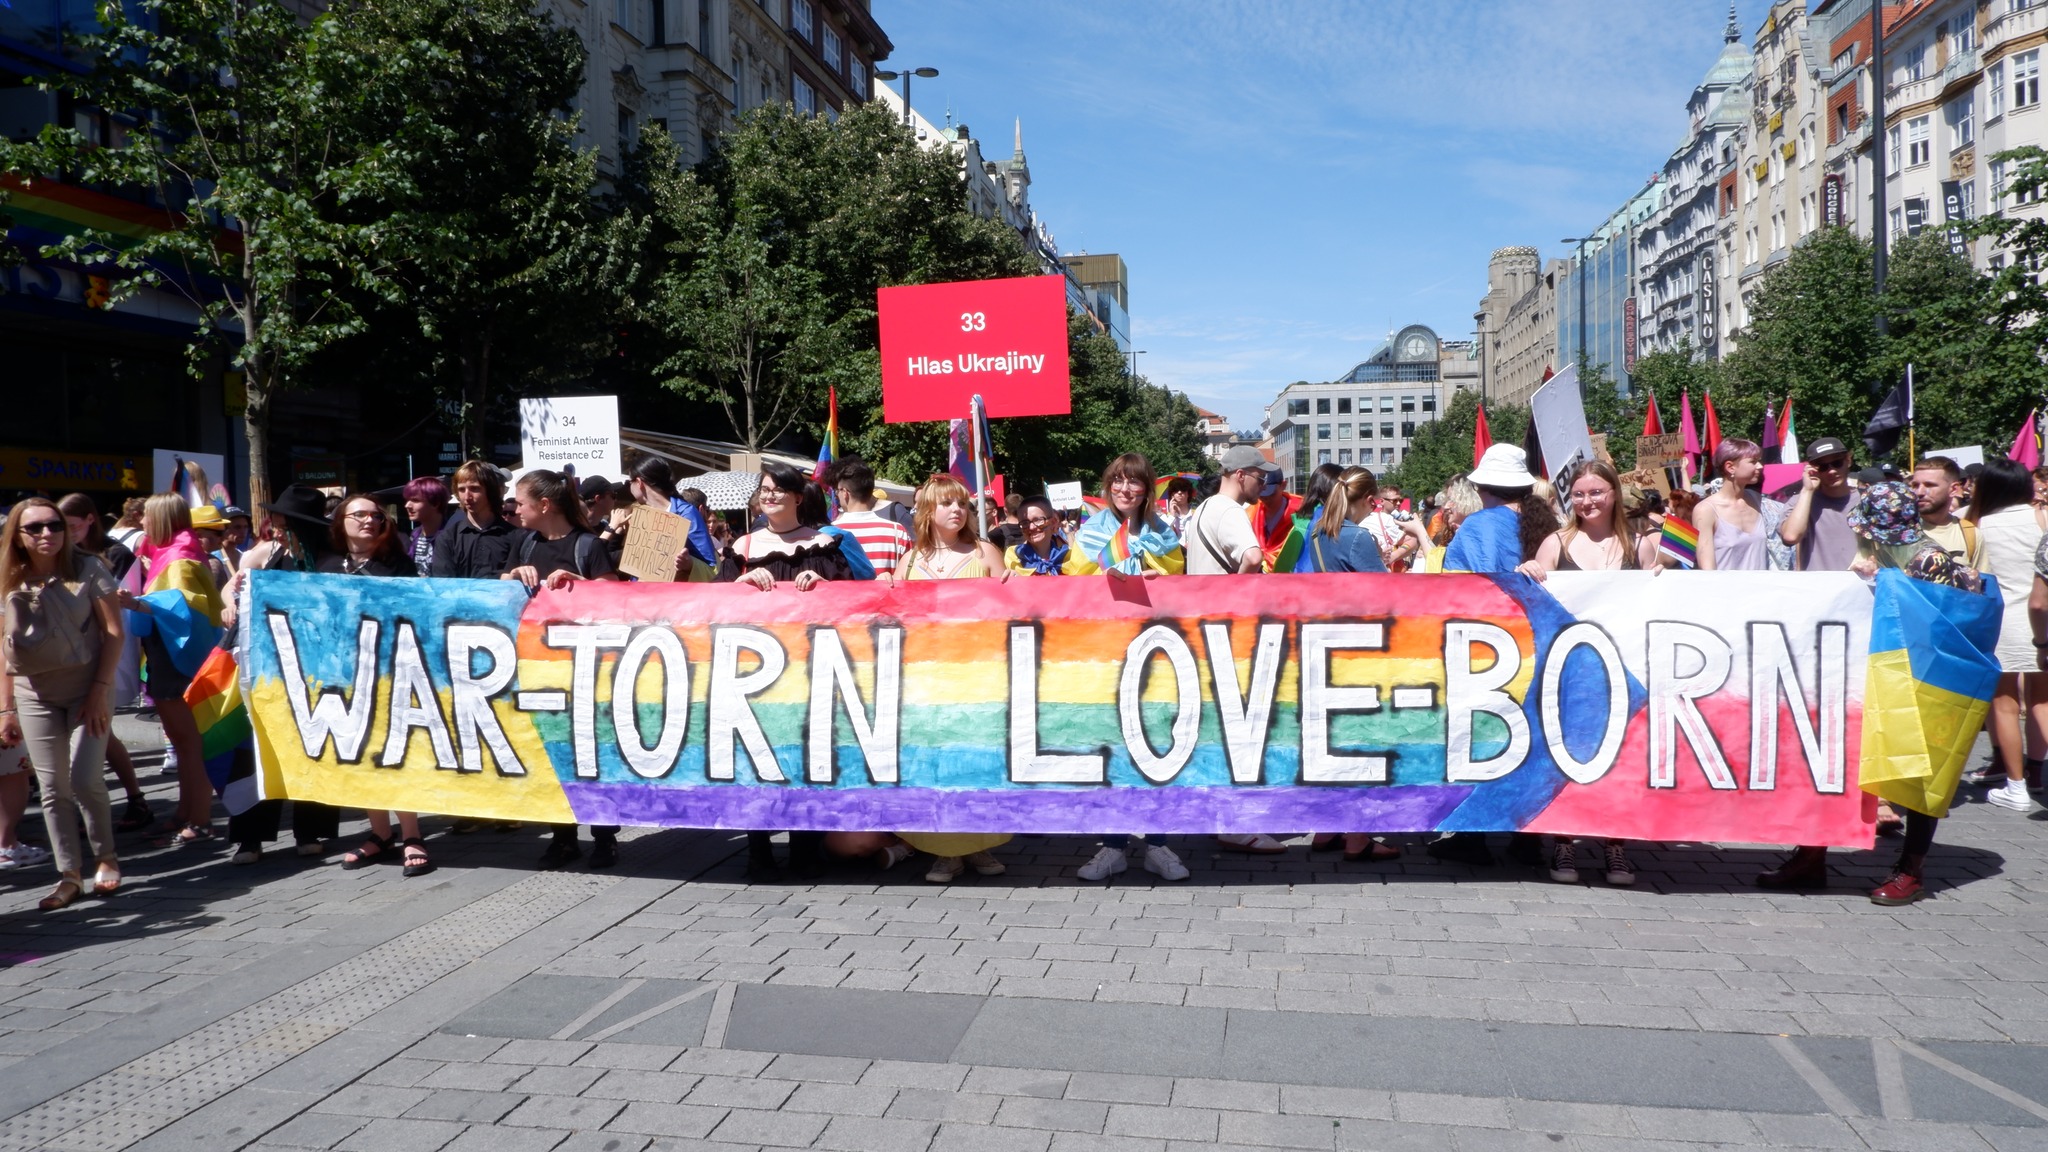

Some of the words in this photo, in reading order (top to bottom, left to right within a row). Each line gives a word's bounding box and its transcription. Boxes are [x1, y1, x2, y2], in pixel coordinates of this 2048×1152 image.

[1702, 256, 1713, 339] CASINO
[961, 312, 986, 332] 33
[908, 356, 954, 376] Hlas
[958, 351, 1045, 375] Ukrajiny
[562, 416, 576, 427] 34
[533, 437, 571, 446] Feminist
[573, 436, 609, 445] Antiwar
[438, 453, 461, 461] MARKET
[539, 450, 589, 460] Resistance
[591, 450, 604, 459] CZ
[26, 456, 118, 481] SPARKYS
[652, 511, 679, 536] BETTER
[629, 527, 641, 546] TO
[641, 530, 653, 549] BE
[266, 609, 904, 784] WAR-TORN
[1007, 619, 1849, 794] LOVE-BORN
